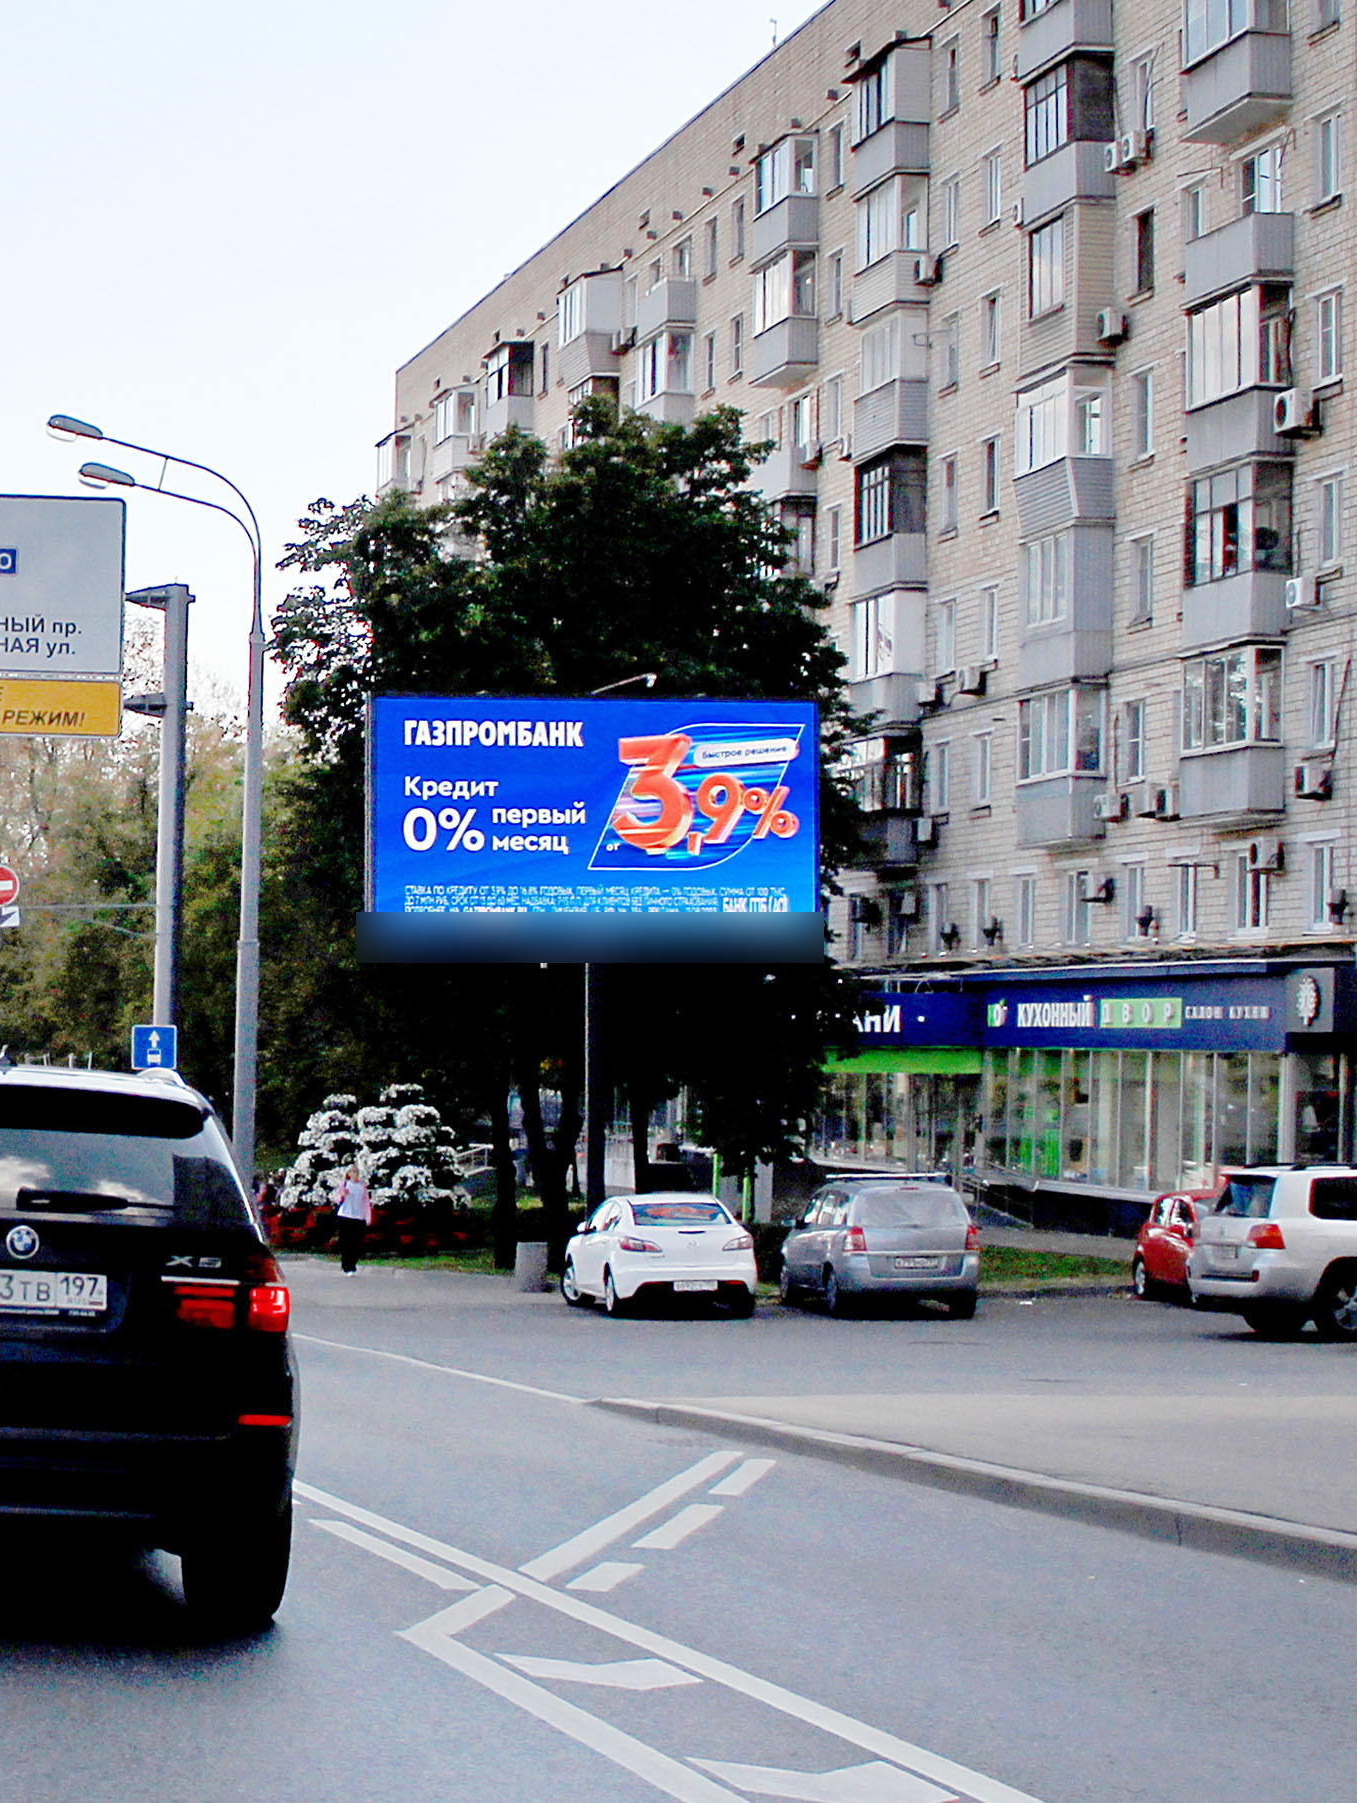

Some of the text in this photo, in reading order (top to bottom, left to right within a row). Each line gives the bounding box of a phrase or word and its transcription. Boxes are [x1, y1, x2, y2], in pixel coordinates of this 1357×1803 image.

[52, 621, 83, 638] пр.
[46, 641, 76, 658] ул.
[2, 709, 86, 727] РЕЖИМ!
[403, 719, 585, 747] ГАЗПРОМБАНК
[701, 745, 788, 760] Быстрое решение
[404, 775, 500, 801] Кредит
[605, 733, 800, 856] от 3,9%
[402, 800, 586, 852] 0% первый
[492, 835, 571, 855] месяц
[1017, 995, 1176, 1028] КУХОННЫЙ ДВОР
[1185, 1005, 1272, 1021] САЛОН КУХНИ
[59, 1275, 100, 1297] 197
